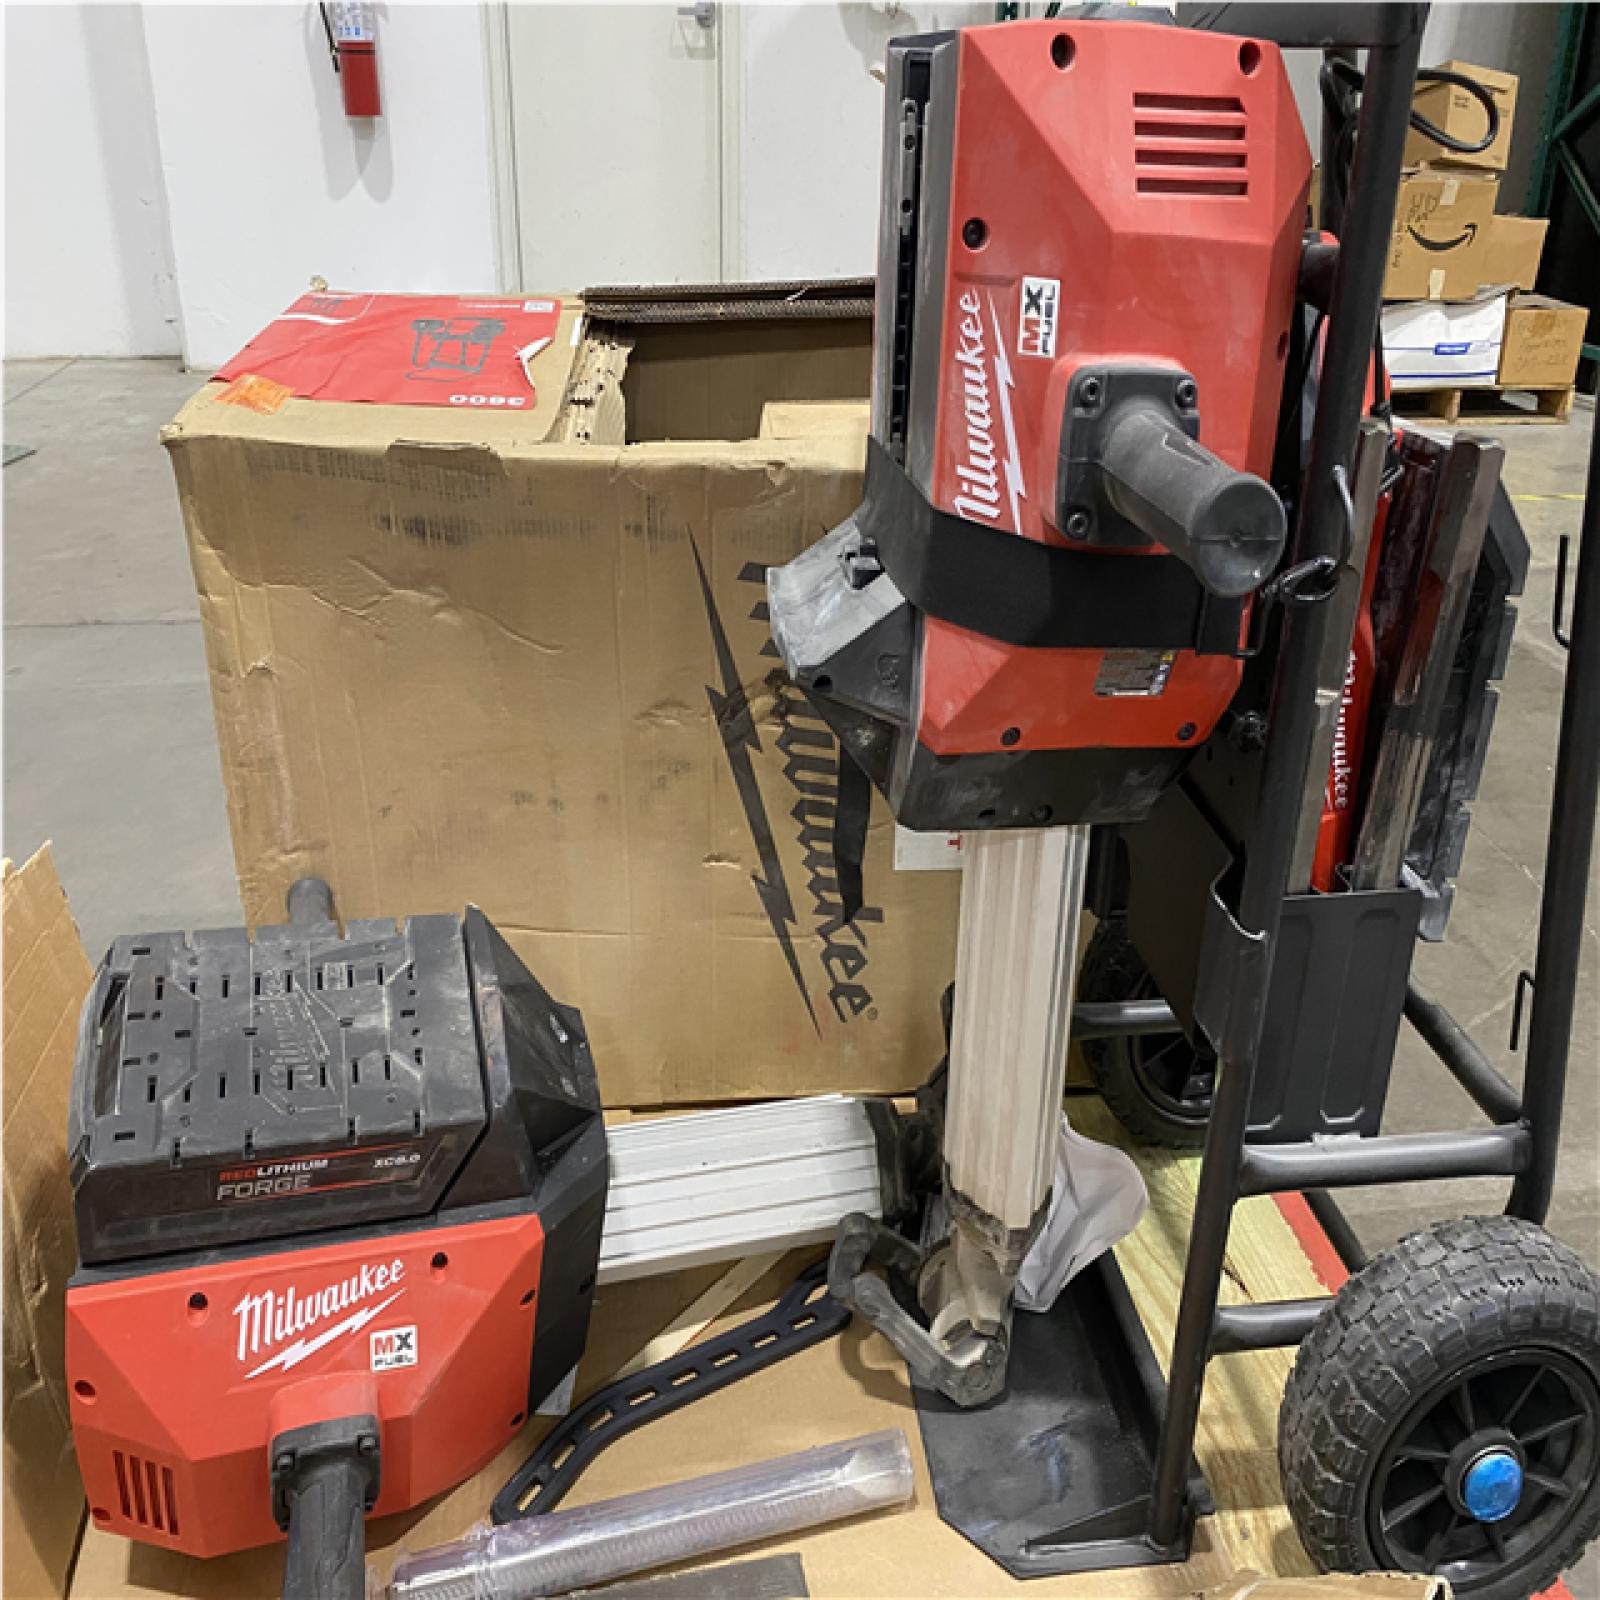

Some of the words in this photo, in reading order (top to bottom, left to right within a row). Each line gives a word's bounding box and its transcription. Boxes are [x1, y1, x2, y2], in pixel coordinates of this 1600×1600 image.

[1021, 284, 1043, 351] MX
[1041, 283, 1056, 354] FUEL
[1333, 651, 1358, 809] laukee
[738, 560, 884, 1023] waukee
[216, 1174, 313, 1201] FORGE
[219, 1158, 329, 1181] REDLITHIUM
[232, 1258, 406, 1362] Milwaukee
[374, 1331, 413, 1356] MX
[374, 1354, 414, 1368] FUEL
